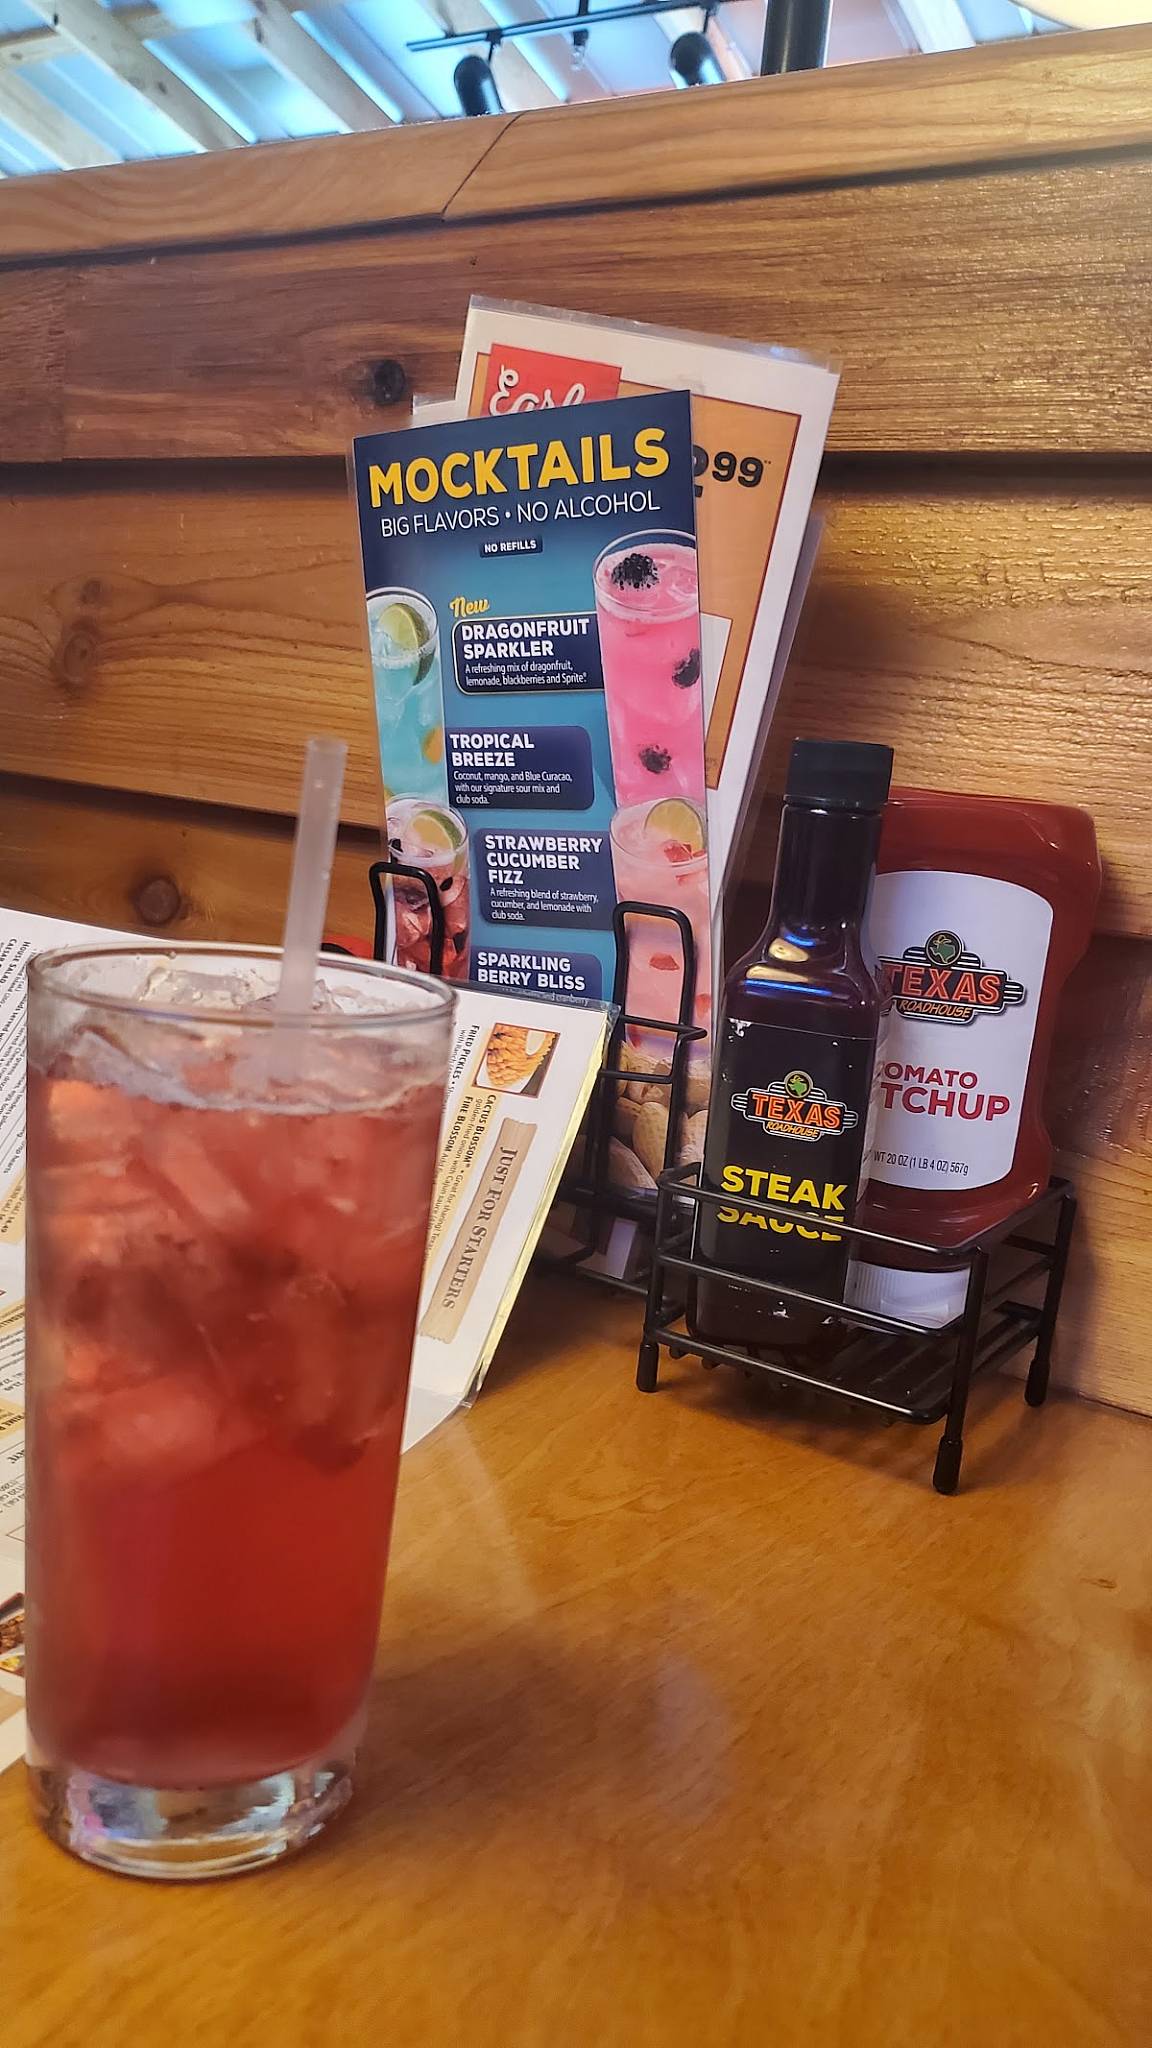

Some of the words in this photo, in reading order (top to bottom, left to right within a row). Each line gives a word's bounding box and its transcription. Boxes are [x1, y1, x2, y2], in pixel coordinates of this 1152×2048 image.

[368, 427, 670, 508] MOCKTAILS
[381, 516, 410, 538] BIG
[413, 506, 500, 534] FLAVORS
[517, 501, 550, 523] NO
[553, 490, 661, 519] ALCOHOL
[484, 542, 498, 553] NO
[500, 538, 537, 552] REFILLS
[450, 596, 490, 618] New
[461, 618, 590, 641] DRAGONFRUIT
[463, 640, 554, 660] SPARKLER
[465, 664, 471, 674] A
[471, 662, 506, 676] refreshing
[507, 662, 520, 672] mix
[521, 661, 529, 671] of
[530, 659, 573, 673] dragonfruit,
[466, 675, 502, 687] lemonade,
[502, 673, 545, 685] blackberries
[546, 673, 561, 684] and
[450, 733, 535, 749] TROPICAL
[452, 752, 516, 767] BREEZE
[453, 770, 483, 782] Coconut,
[484, 772, 510, 784] mango,
[510, 771, 524, 781] and
[525, 771, 540, 781] Blue
[541, 772, 573, 783] Curacao,
[455, 783, 470, 793] with
[471, 784, 483, 793] our
[483, 783, 515, 796] signature
[515, 784, 531, 793] sour
[532, 783, 545, 793] mix
[546, 783, 560, 794] and
[456, 795, 471, 805] club
[471, 795, 490, 805] soda.
[485, 834, 603, 854] STRAWBERRY
[486, 852, 581, 870] CUCUMBER
[488, 869, 524, 885] FIZZ
[490, 888, 496, 897] A
[496, 888, 530, 901] refreshing
[531, 889, 551, 900] blend
[551, 890, 559, 900] of
[560, 892, 599, 904] strawberry,
[491, 900, 526, 911] cucumber,
[526, 901, 540, 911] and
[541, 902, 575, 912] lemonade
[576, 904, 592, 913] with
[492, 911, 506, 920] club
[507, 911, 526, 921] soda.
[12, 942, 32, 962] HOUSE
[477, 951, 571, 973] SPARKLING
[477, 968, 532, 987] BERRY
[537, 973, 586, 991] BLISS
[880, 963, 1001, 1004] TEXAS
[900, 1000, 973, 1018] ROADHOUSE
[457, 1030, 467, 1043] with
[464, 1025, 480, 1047] FRIED
[452, 1048, 471, 1080] PICKLES
[884, 1062, 978, 1089] OMATO
[459, 1096, 474, 1113] FIRE
[478, 1094, 497, 1124] CACTUS
[752, 1093, 841, 1129] TEXAS
[880, 1082, 1010, 1121] TCHUP
[462, 1099, 484, 1138] golden-fried
[444, 1115, 466, 1152] BLOSSOM
[766, 1121, 820, 1138] ROADHOUSE
[455, 1139, 468, 1158] onion
[449, 1161, 460, 1174] with
[489, 1145, 518, 1185] JUST
[874, 1151, 886, 1162] WT
[887, 1153, 897, 1165] 20
[899, 1155, 909, 1167] OZ
[909, 1157, 917, 1169] (1
[918, 1158, 928, 1170] LB
[929, 1160, 935, 1170] 4
[936, 1160, 949, 1174] OZ)
[950, 1162, 969, 1176] 567g
[440, 1176, 454, 1194] Cajun
[452, 1175, 464, 1193] Great
[720, 1165, 848, 1211] STEAK
[447, 1195, 456, 1203] for
[475, 1188, 503, 1224] FOR
[434, 1205, 452, 1231] sharing!
[441, 1225, 489, 1311] STARTERS
